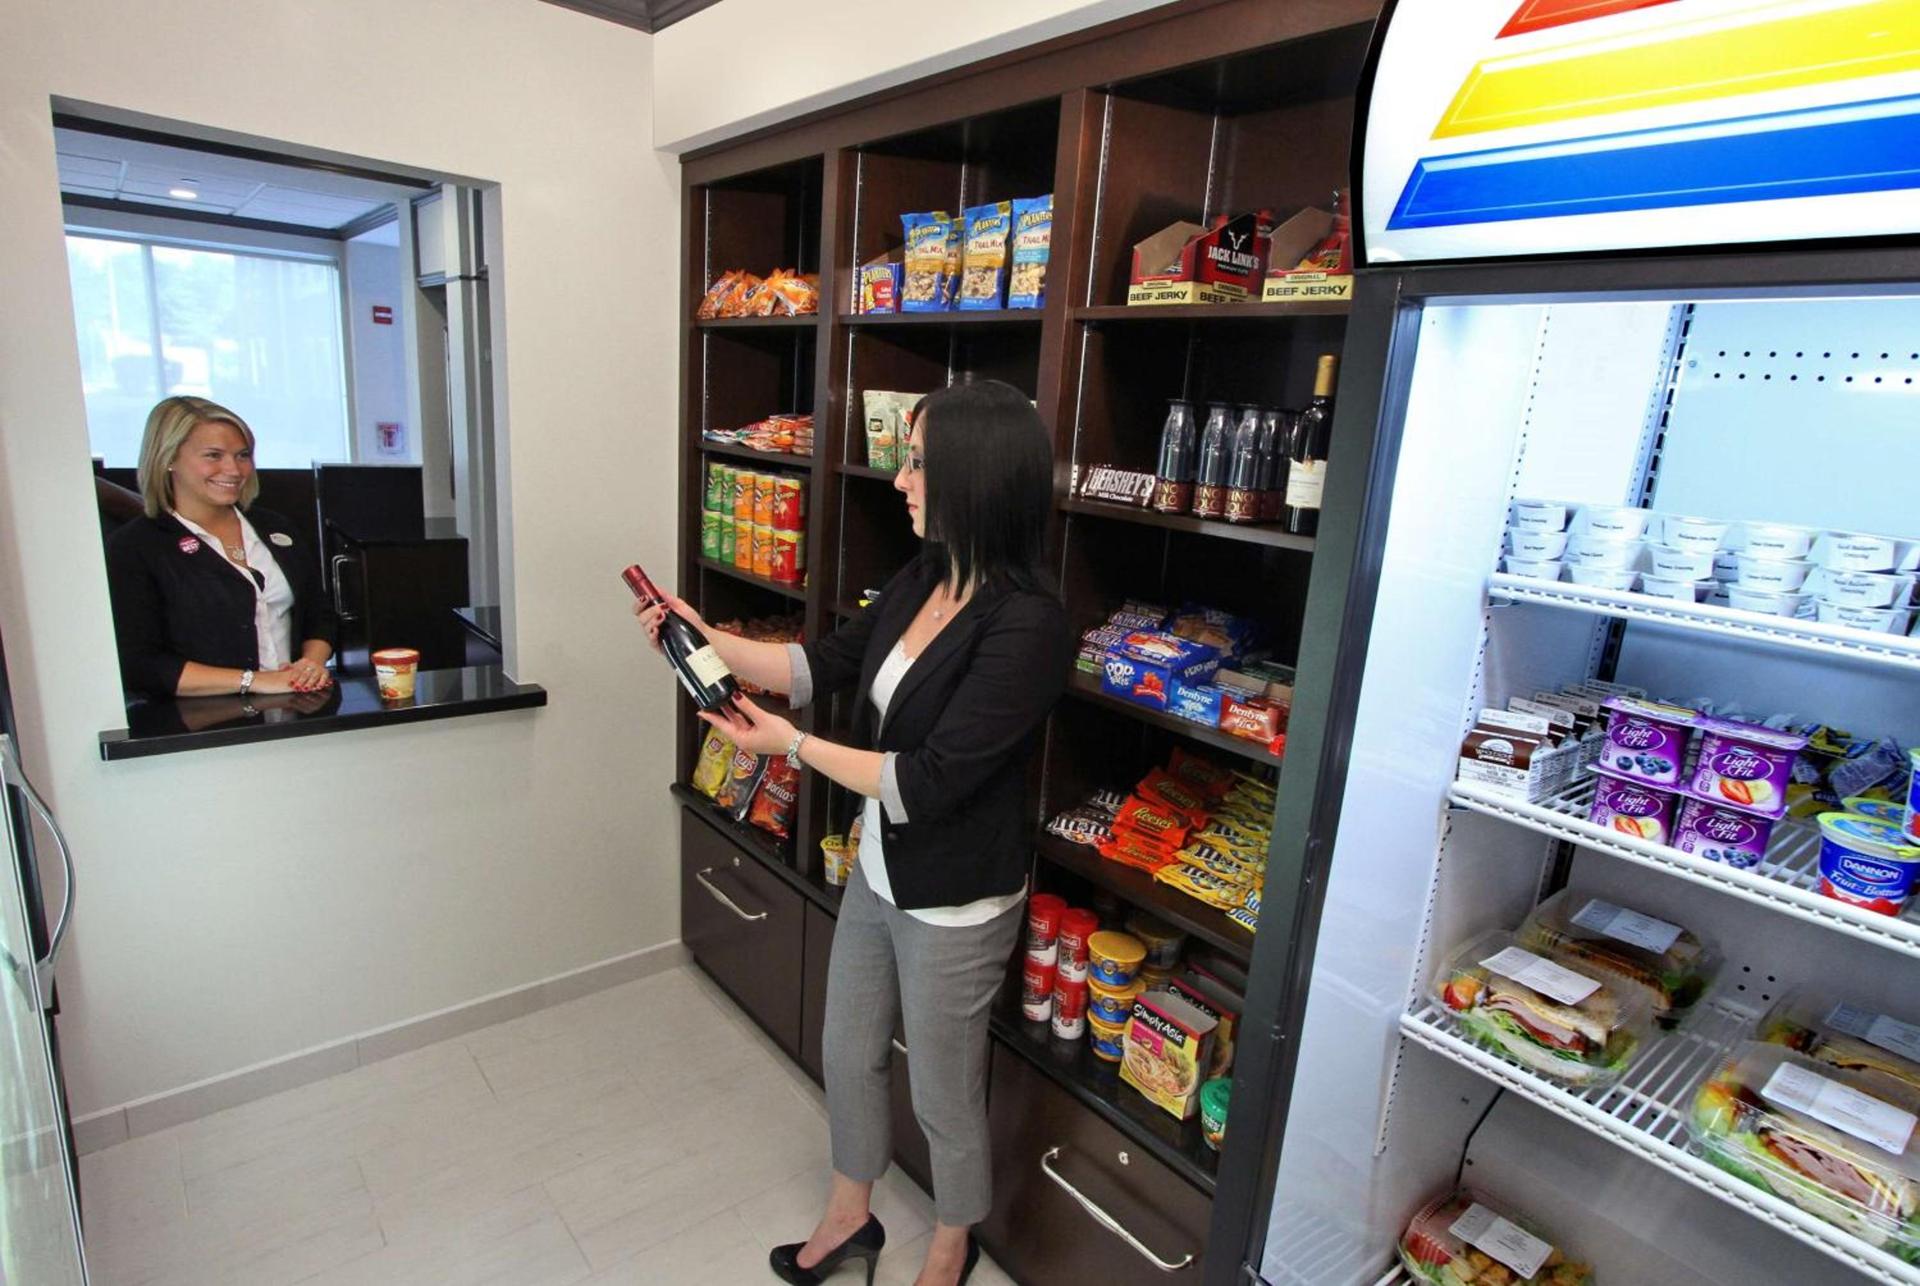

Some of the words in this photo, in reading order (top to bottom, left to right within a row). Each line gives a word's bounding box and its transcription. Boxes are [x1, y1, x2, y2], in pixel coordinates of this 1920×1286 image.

[1207, 245, 1231, 262] JACK
[1129, 292, 1153, 302] BEEF
[1154, 290, 1188, 301] JERKY
[1266, 287, 1299, 297] BEEF
[1302, 285, 1348, 296] JERKY
[1087, 467, 1156, 497] HERSHEY'S
[1177, 686, 1214, 705] Dentyne
[1228, 704, 1270, 722] Dentyne
[1619, 725, 1654, 739] Light
[1721, 754, 1760, 769] Light
[1617, 792, 1650, 806] Light
[1705, 818, 1742, 832] Light
[1842, 859, 1900, 880] DANNON
[1829, 869, 1857, 888] Fruit
[1133, 1003, 1163, 1031] Simply
[1161, 1023, 1185, 1044] Asia
